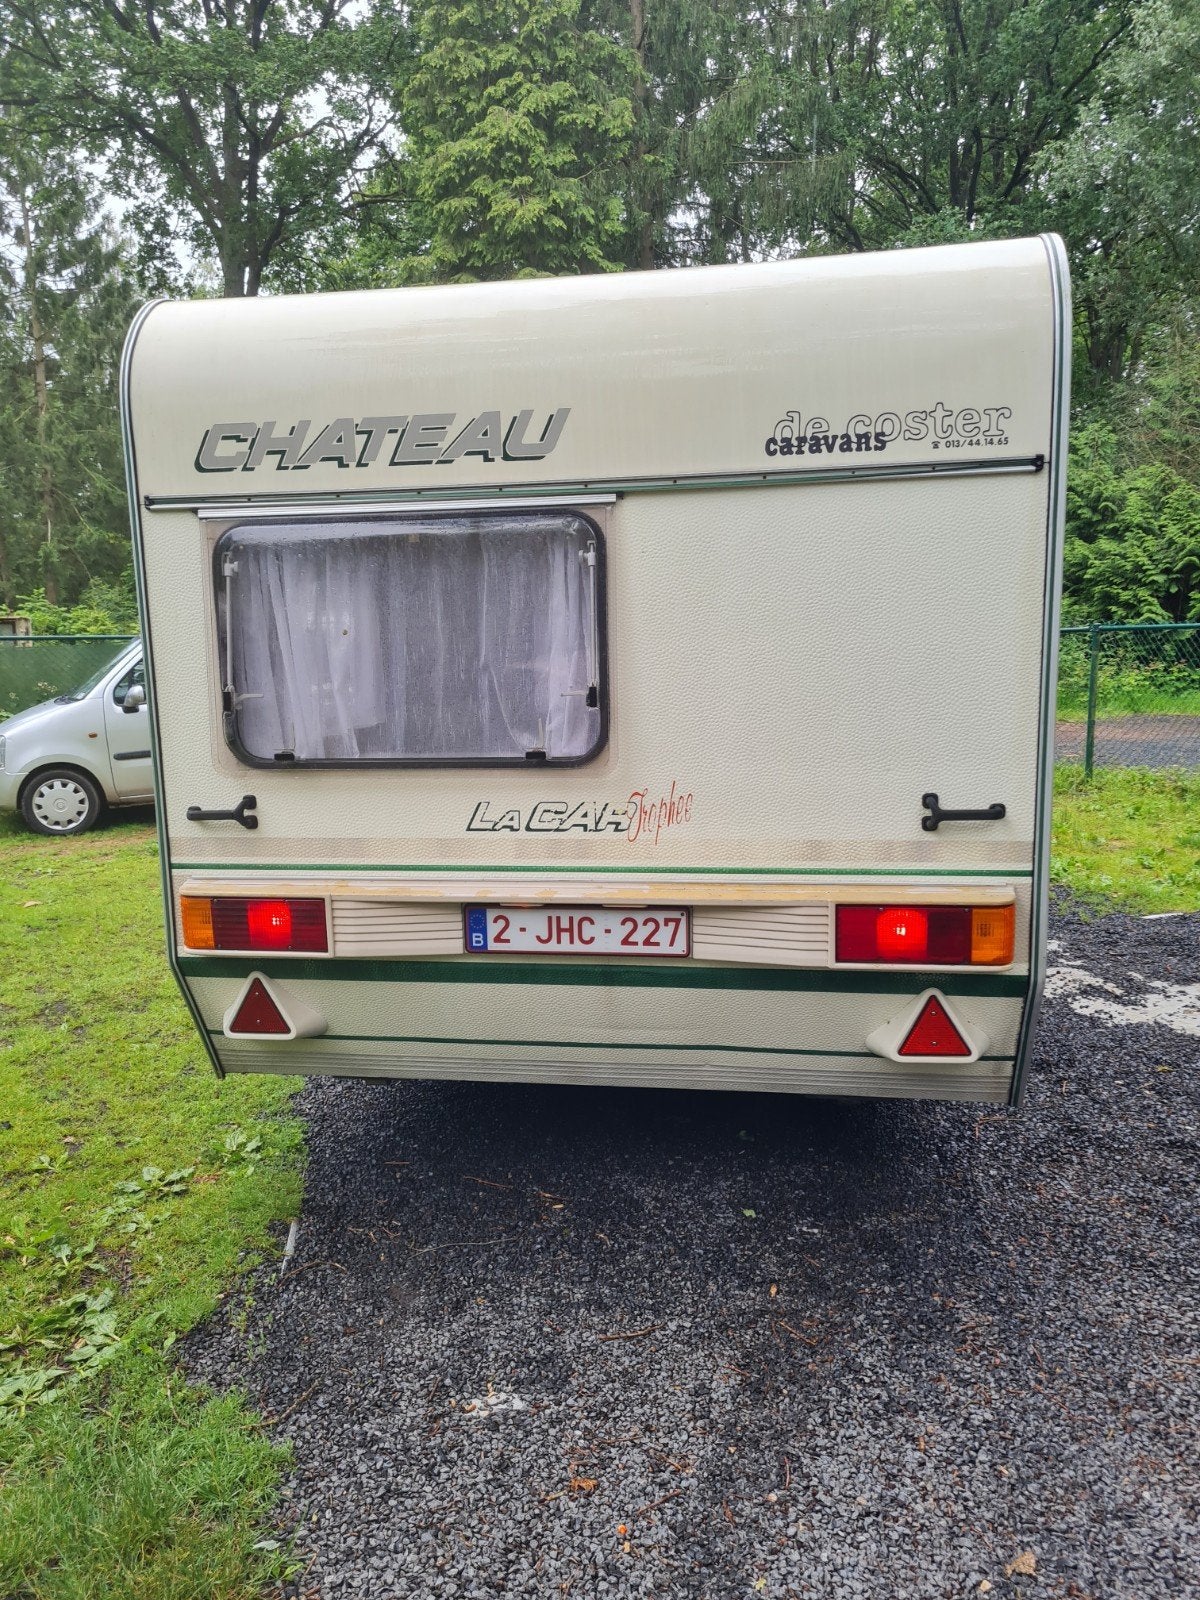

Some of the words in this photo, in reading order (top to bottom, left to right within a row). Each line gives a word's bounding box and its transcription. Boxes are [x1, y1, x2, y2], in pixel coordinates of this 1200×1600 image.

[773, 410, 831, 448] de
[846, 401, 1013, 443] coster
[194, 407, 572, 474] CHATEAU
[764, 431, 888, 457] caravans
[944, 436, 1009, 449] 013/44.14.65
[472, 933, 484, 947] B
